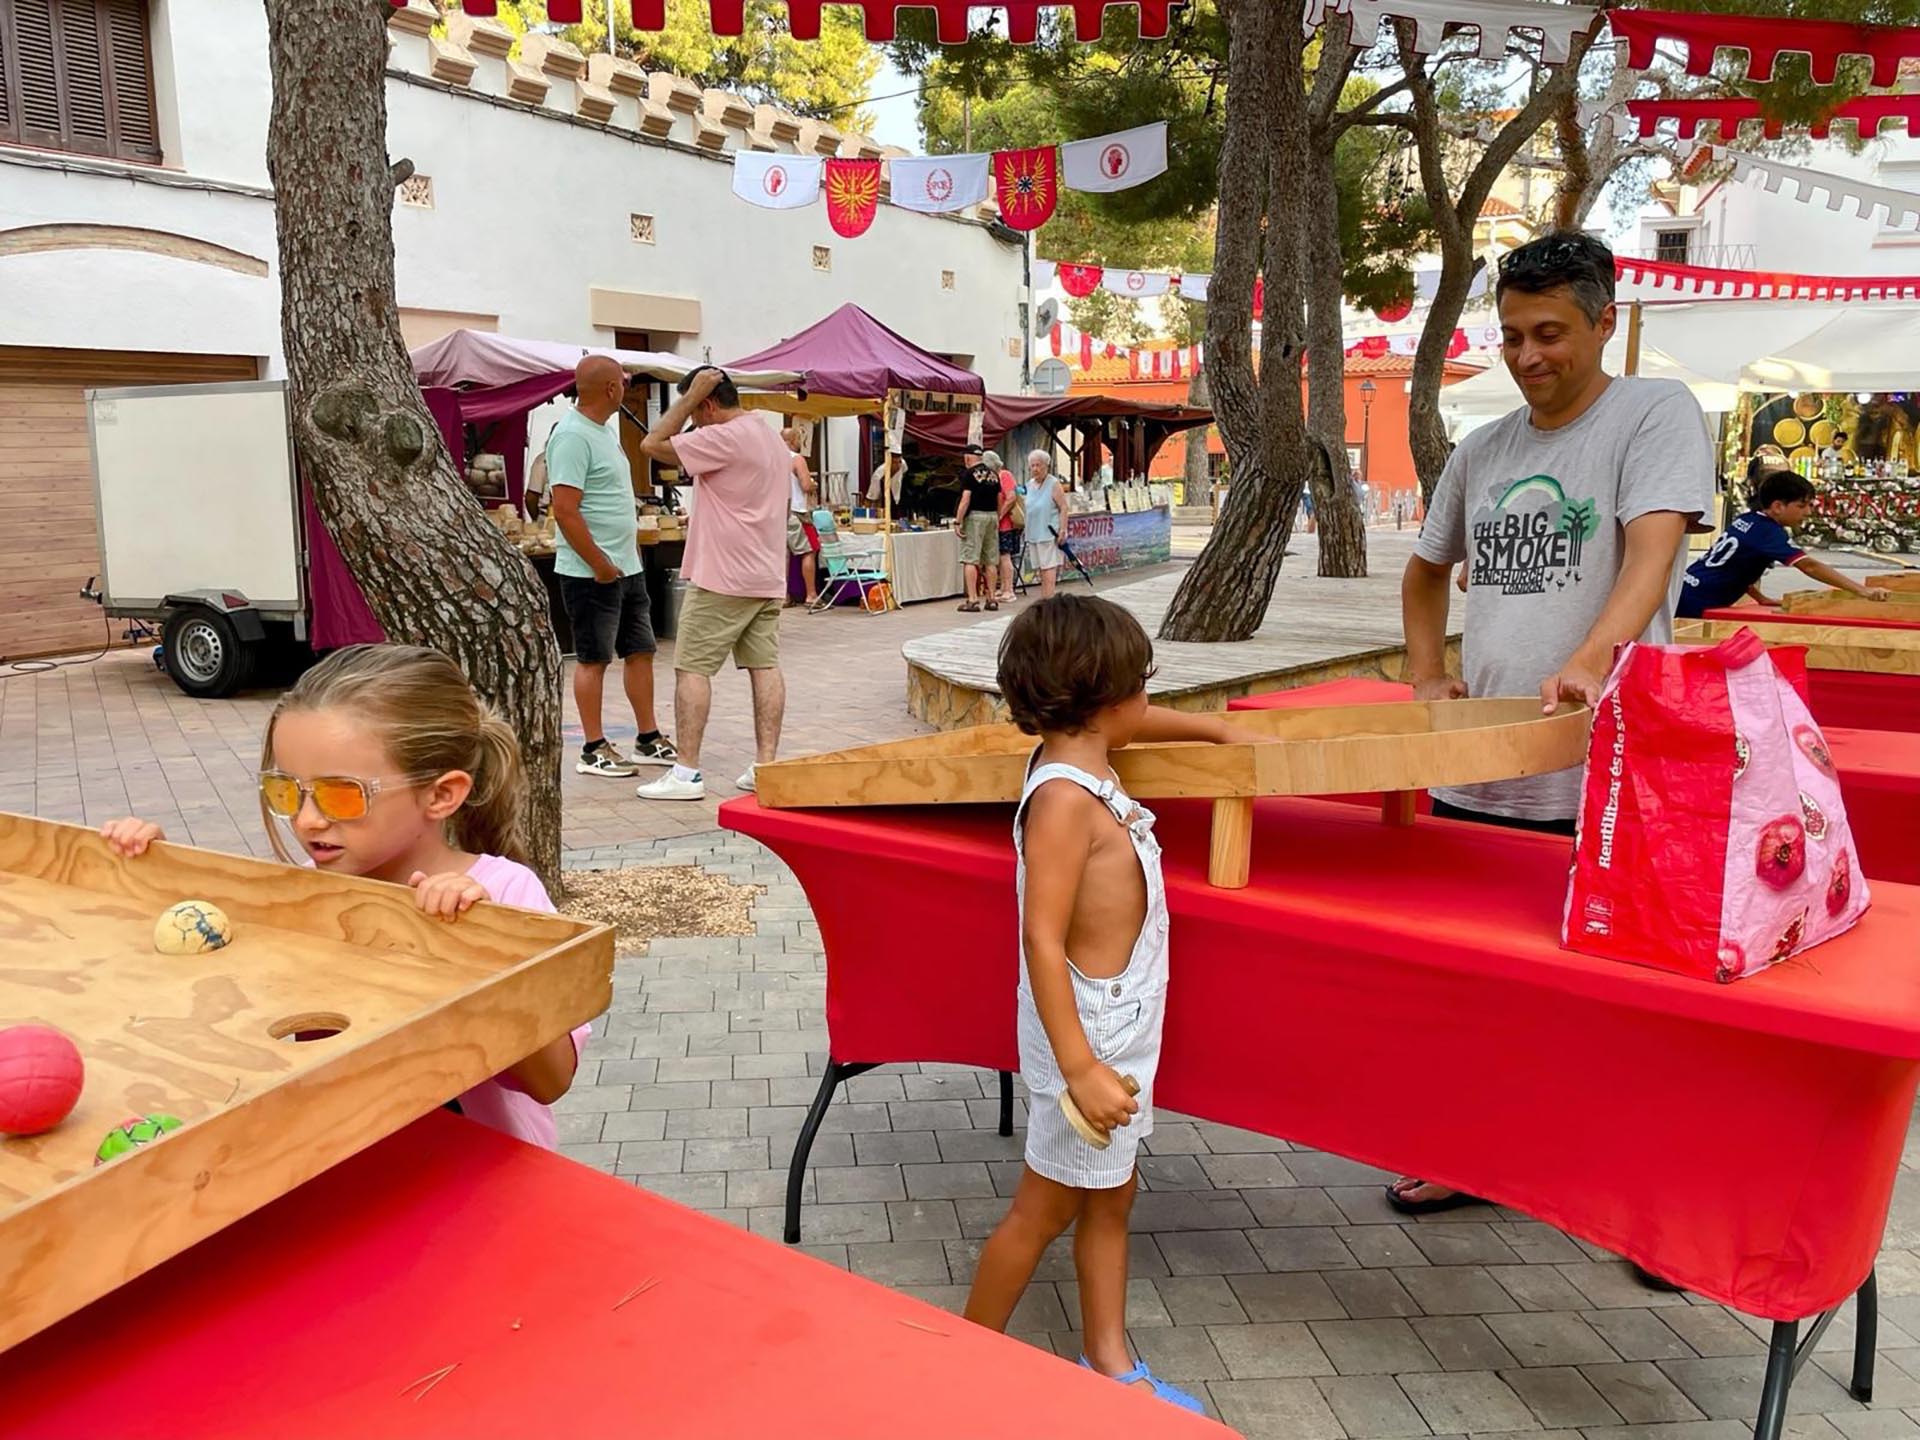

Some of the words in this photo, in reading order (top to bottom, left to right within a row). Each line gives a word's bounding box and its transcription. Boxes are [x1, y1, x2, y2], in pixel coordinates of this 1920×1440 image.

[1067, 516, 1115, 538] EMBOTITS
[1474, 521, 1501, 539] THE
[1504, 511, 1548, 538] BIG
[1475, 531, 1568, 569] SMOKE
[1472, 566, 1544, 586] FENCHURCH
[1613, 733, 1625, 755] de
[1609, 756, 1623, 777] és
[1598, 777, 1622, 870] Reutilitzar
